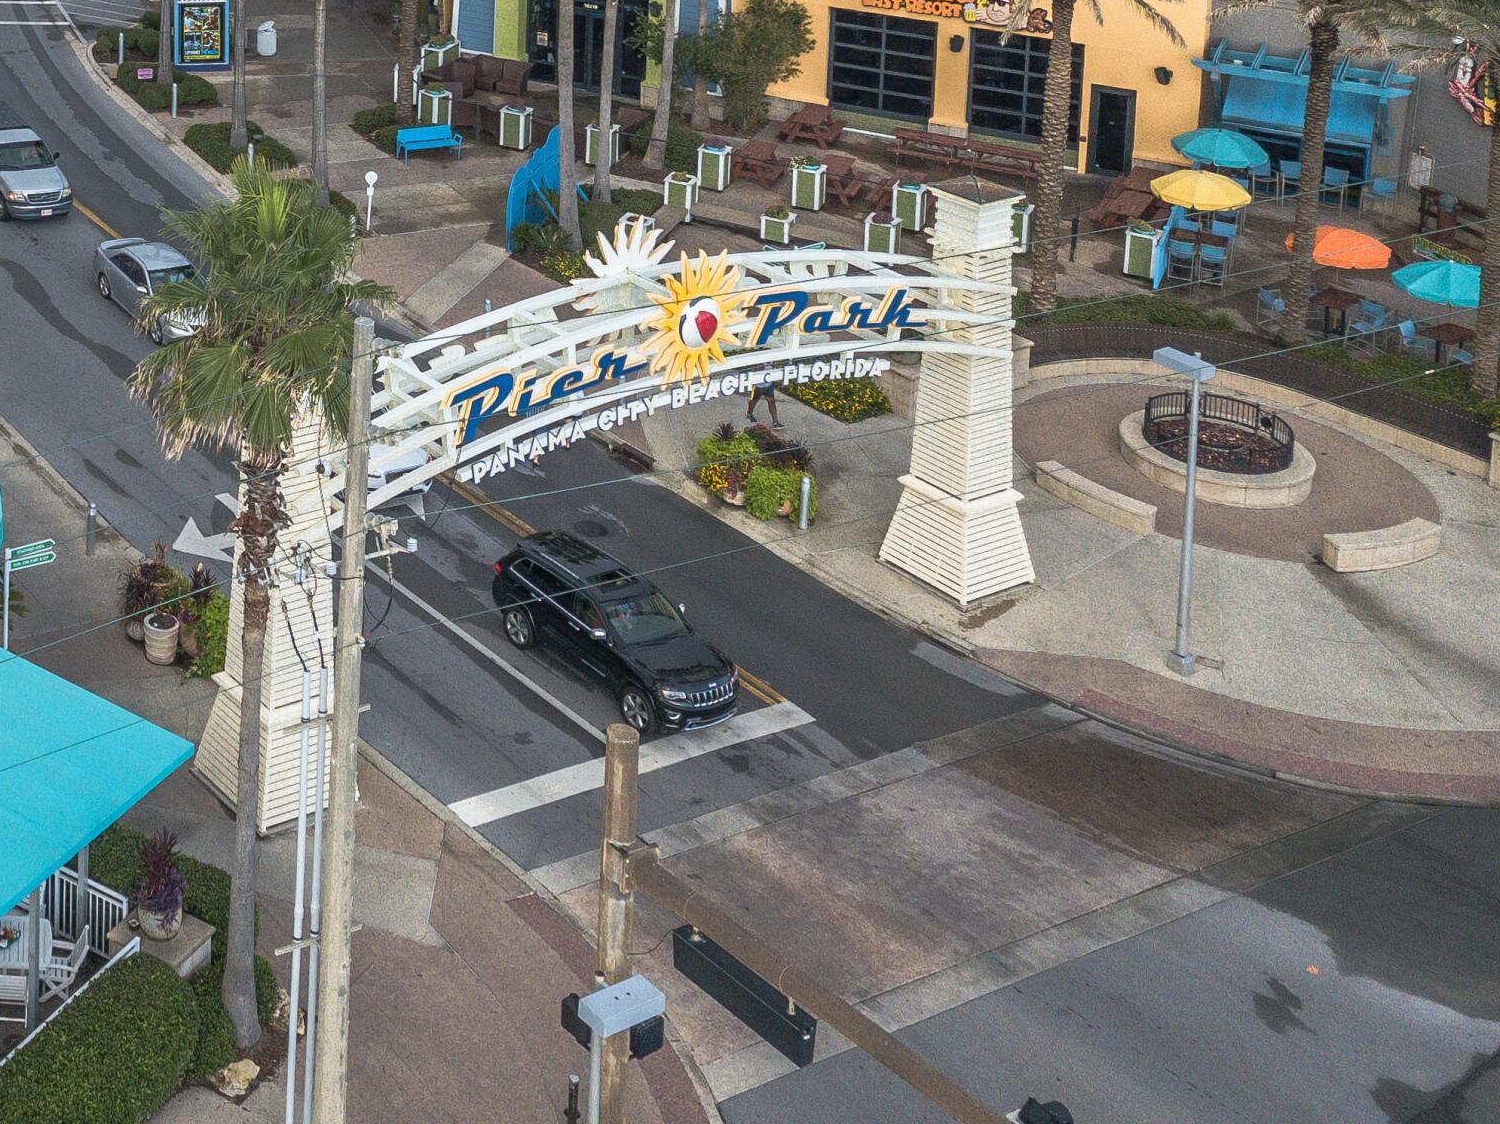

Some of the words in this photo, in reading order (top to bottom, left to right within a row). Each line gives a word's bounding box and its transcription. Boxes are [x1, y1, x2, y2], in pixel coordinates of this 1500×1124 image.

[441, 348, 649, 448] Pier
[744, 285, 930, 348] Park
[472, 427, 587, 485] PANAMA
[597, 393, 655, 432] CITY
[671, 370, 754, 410] BEACH
[782, 356, 884, 389] FLORIDA
